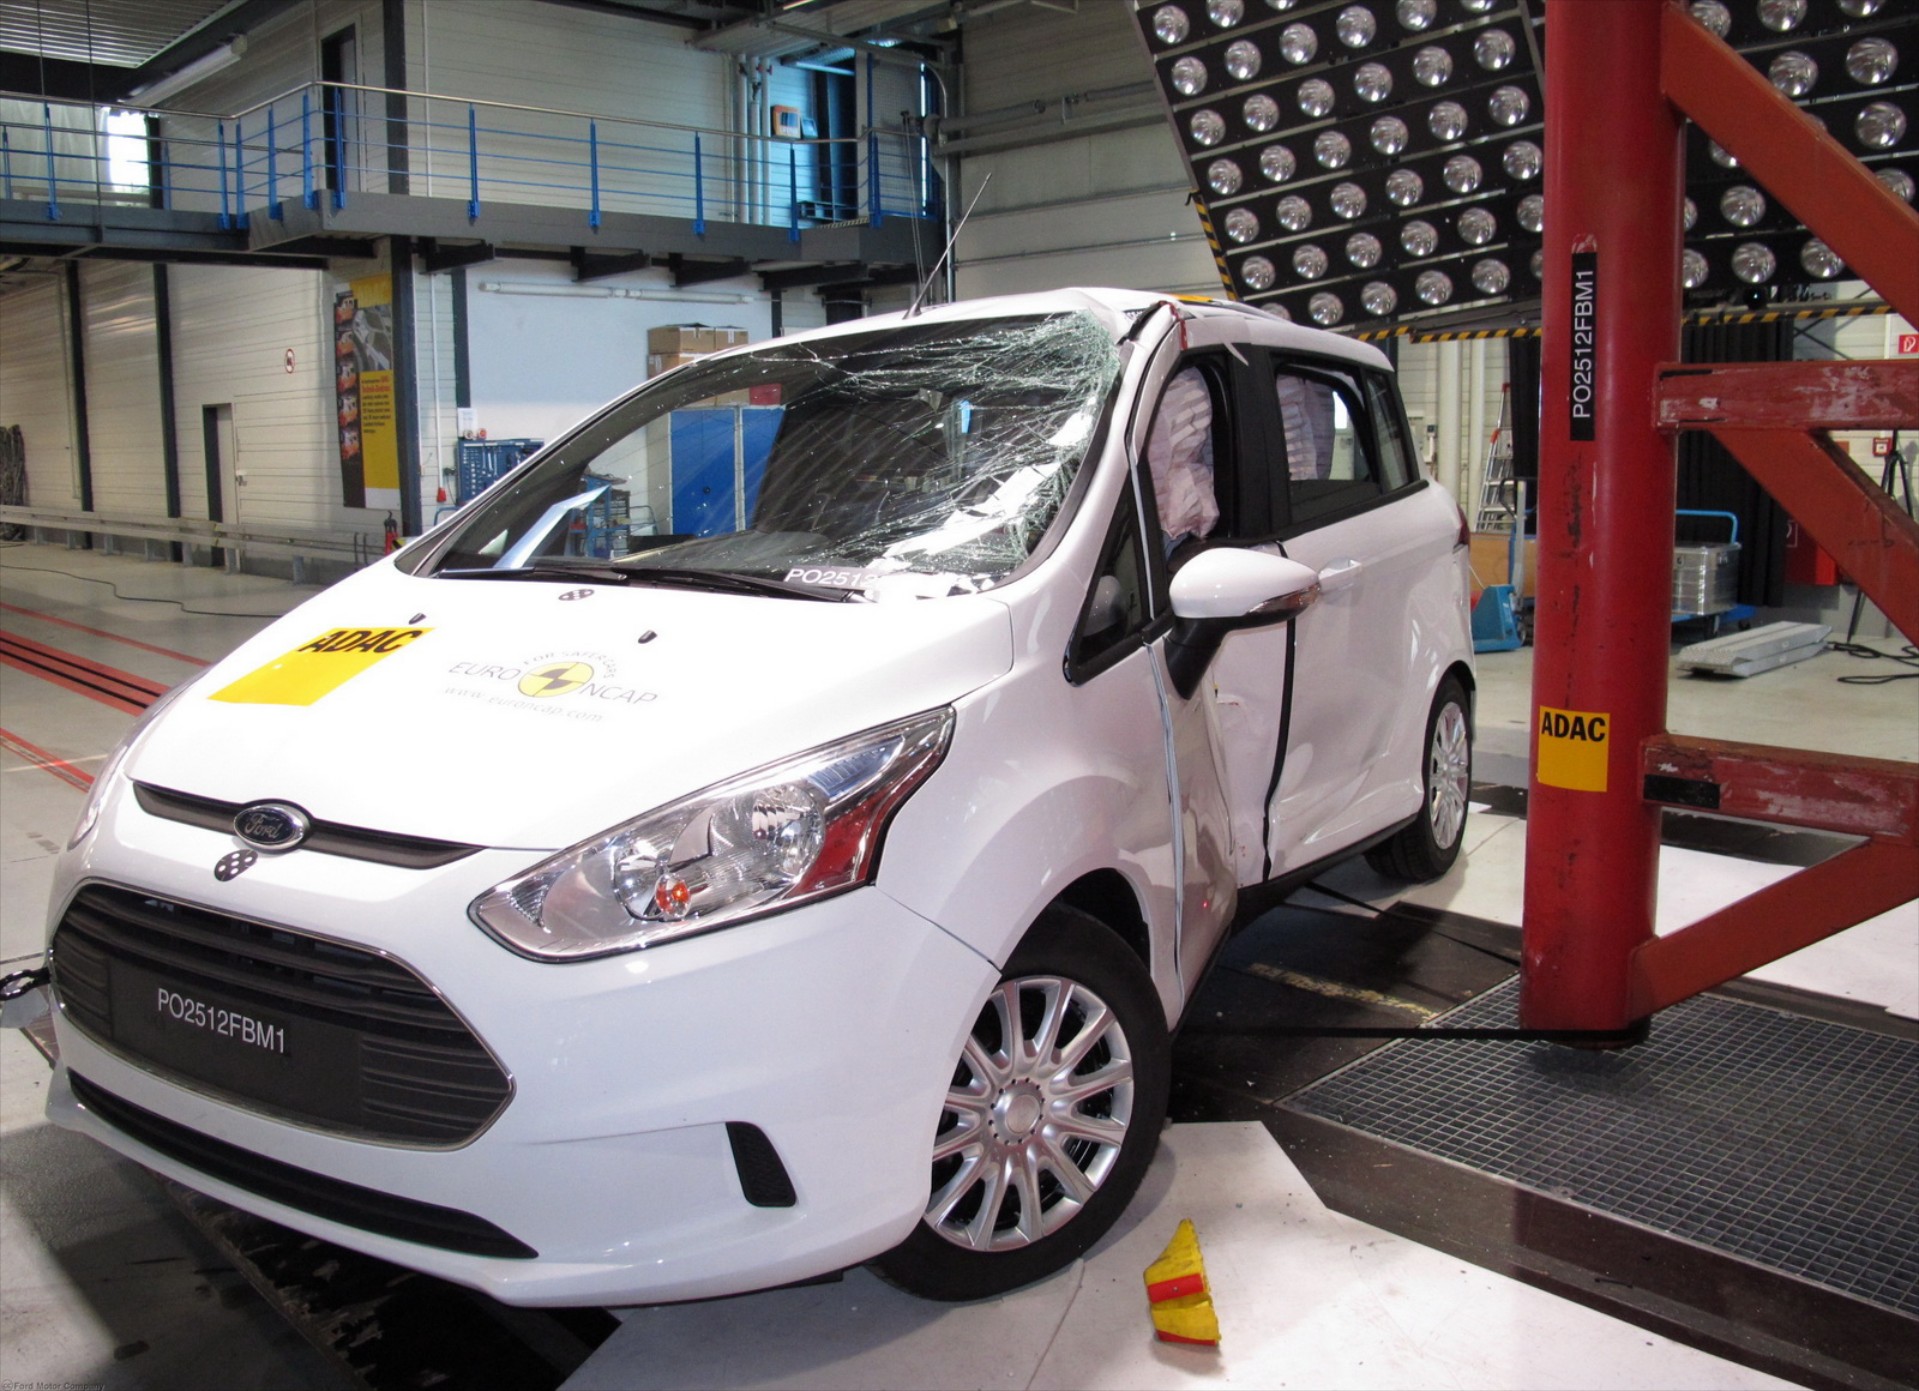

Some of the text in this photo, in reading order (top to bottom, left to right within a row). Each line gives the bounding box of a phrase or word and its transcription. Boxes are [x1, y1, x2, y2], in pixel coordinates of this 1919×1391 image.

[1572, 270, 1595, 419] PO2512FBM1
[297, 629, 423, 654] ADAC
[448, 661, 658, 706] EURO NCAP
[444, 685, 603, 723] www.euroncap.com
[1541, 711, 1606, 742] ADAC
[244, 812, 284, 839] Ford
[158, 987, 284, 1054] PO2512FBM1
